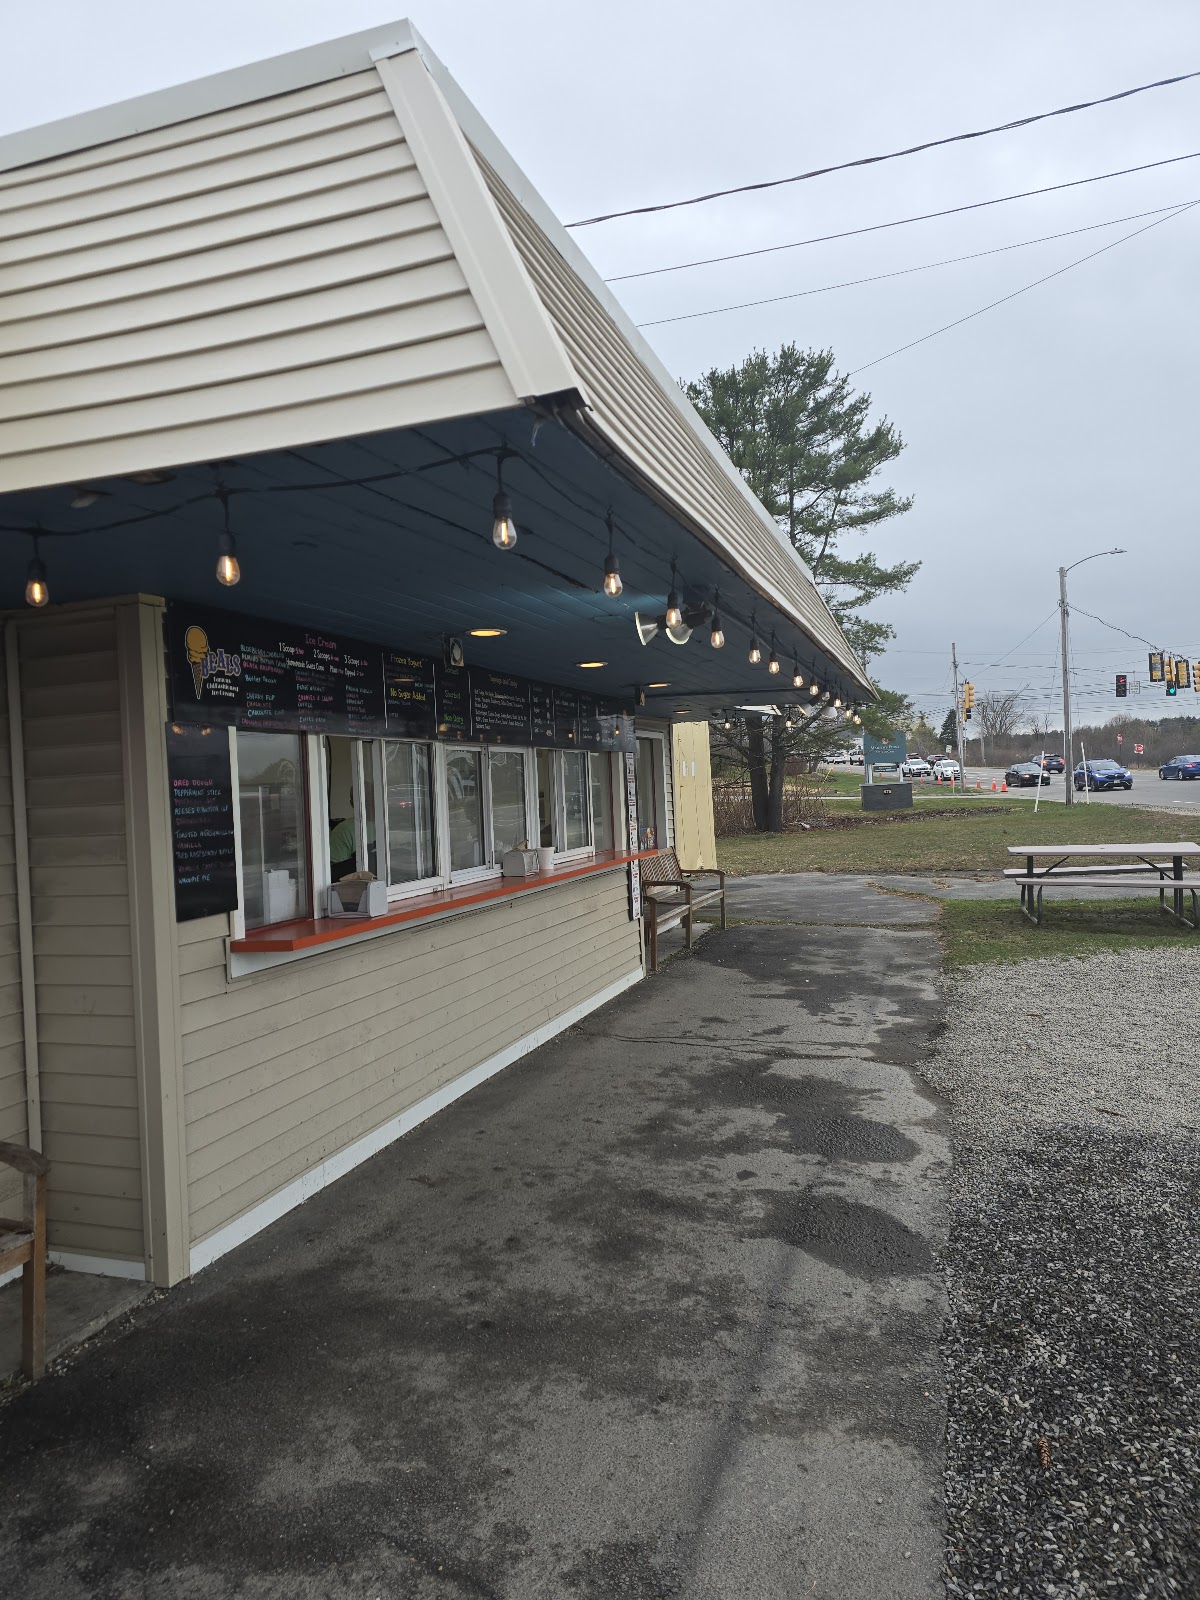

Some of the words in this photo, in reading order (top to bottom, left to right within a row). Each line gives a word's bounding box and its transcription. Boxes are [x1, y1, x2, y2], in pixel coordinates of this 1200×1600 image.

[305, 633, 316, 645] Ice
[317, 636, 337, 650] Cream
[282, 643, 295, 656] Scoop
[313, 648, 317, 658] 2
[317, 650, 330, 662] Scoops
[201, 649, 241, 679] BEALS
[344, 654, 348, 664] 3
[348, 655, 360, 668] Scoops
[390, 653, 407, 665] Frozen
[407, 656, 423, 668] Yogurt
[244, 674, 261, 683] Butter
[390, 687, 397, 697] No
[397, 688, 412, 700] Sugar
[411, 690, 426, 701] Added
[173, 788, 204, 797] PEPPERMINT
[174, 830, 198, 839] TOASTED
[176, 841, 202, 849] VANILLA
[201, 873, 211, 881] PIE
